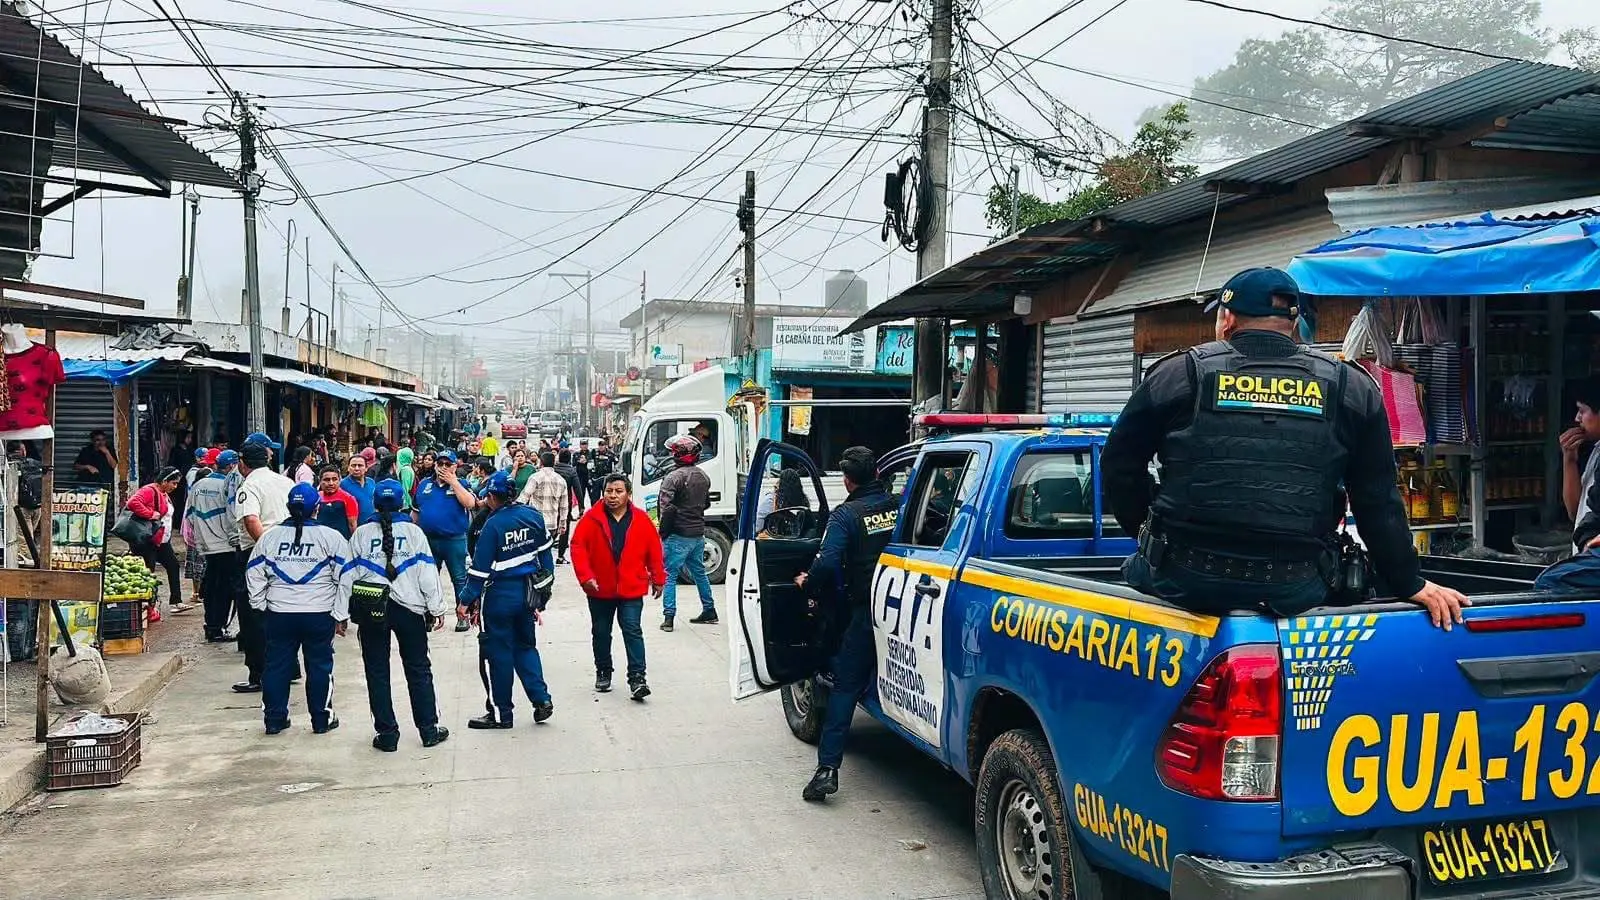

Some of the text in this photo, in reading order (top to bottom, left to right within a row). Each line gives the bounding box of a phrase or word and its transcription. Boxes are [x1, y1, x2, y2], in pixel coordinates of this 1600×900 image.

[776, 334, 784, 344] LA
[785, 332, 811, 345] CABAÑA
[812, 334, 825, 345] DEL
[886, 351, 905, 367] del
[1219, 374, 1323, 399] POLICIA
[1218, 391, 1324, 408] NACIONAL CIVIL
[52, 493, 102, 504] VIDRIO
[51, 503, 105, 513] EMPLADO
[370, 536, 407, 553] PT
[505, 527, 530, 545] PMT
[278, 542, 315, 557] PMT
[991, 595, 1184, 687] COMISARIA 13
[887, 636, 917, 669] SERVICIO
[885, 658, 926, 697] INTEGRIDAD
[1295, 661, 1356, 677] TOYOTA
[878, 675, 938, 730] PROFESIONALISMO
[1074, 782, 1170, 873] GUA-13217
[1423, 818, 1554, 883] GUA-13217
